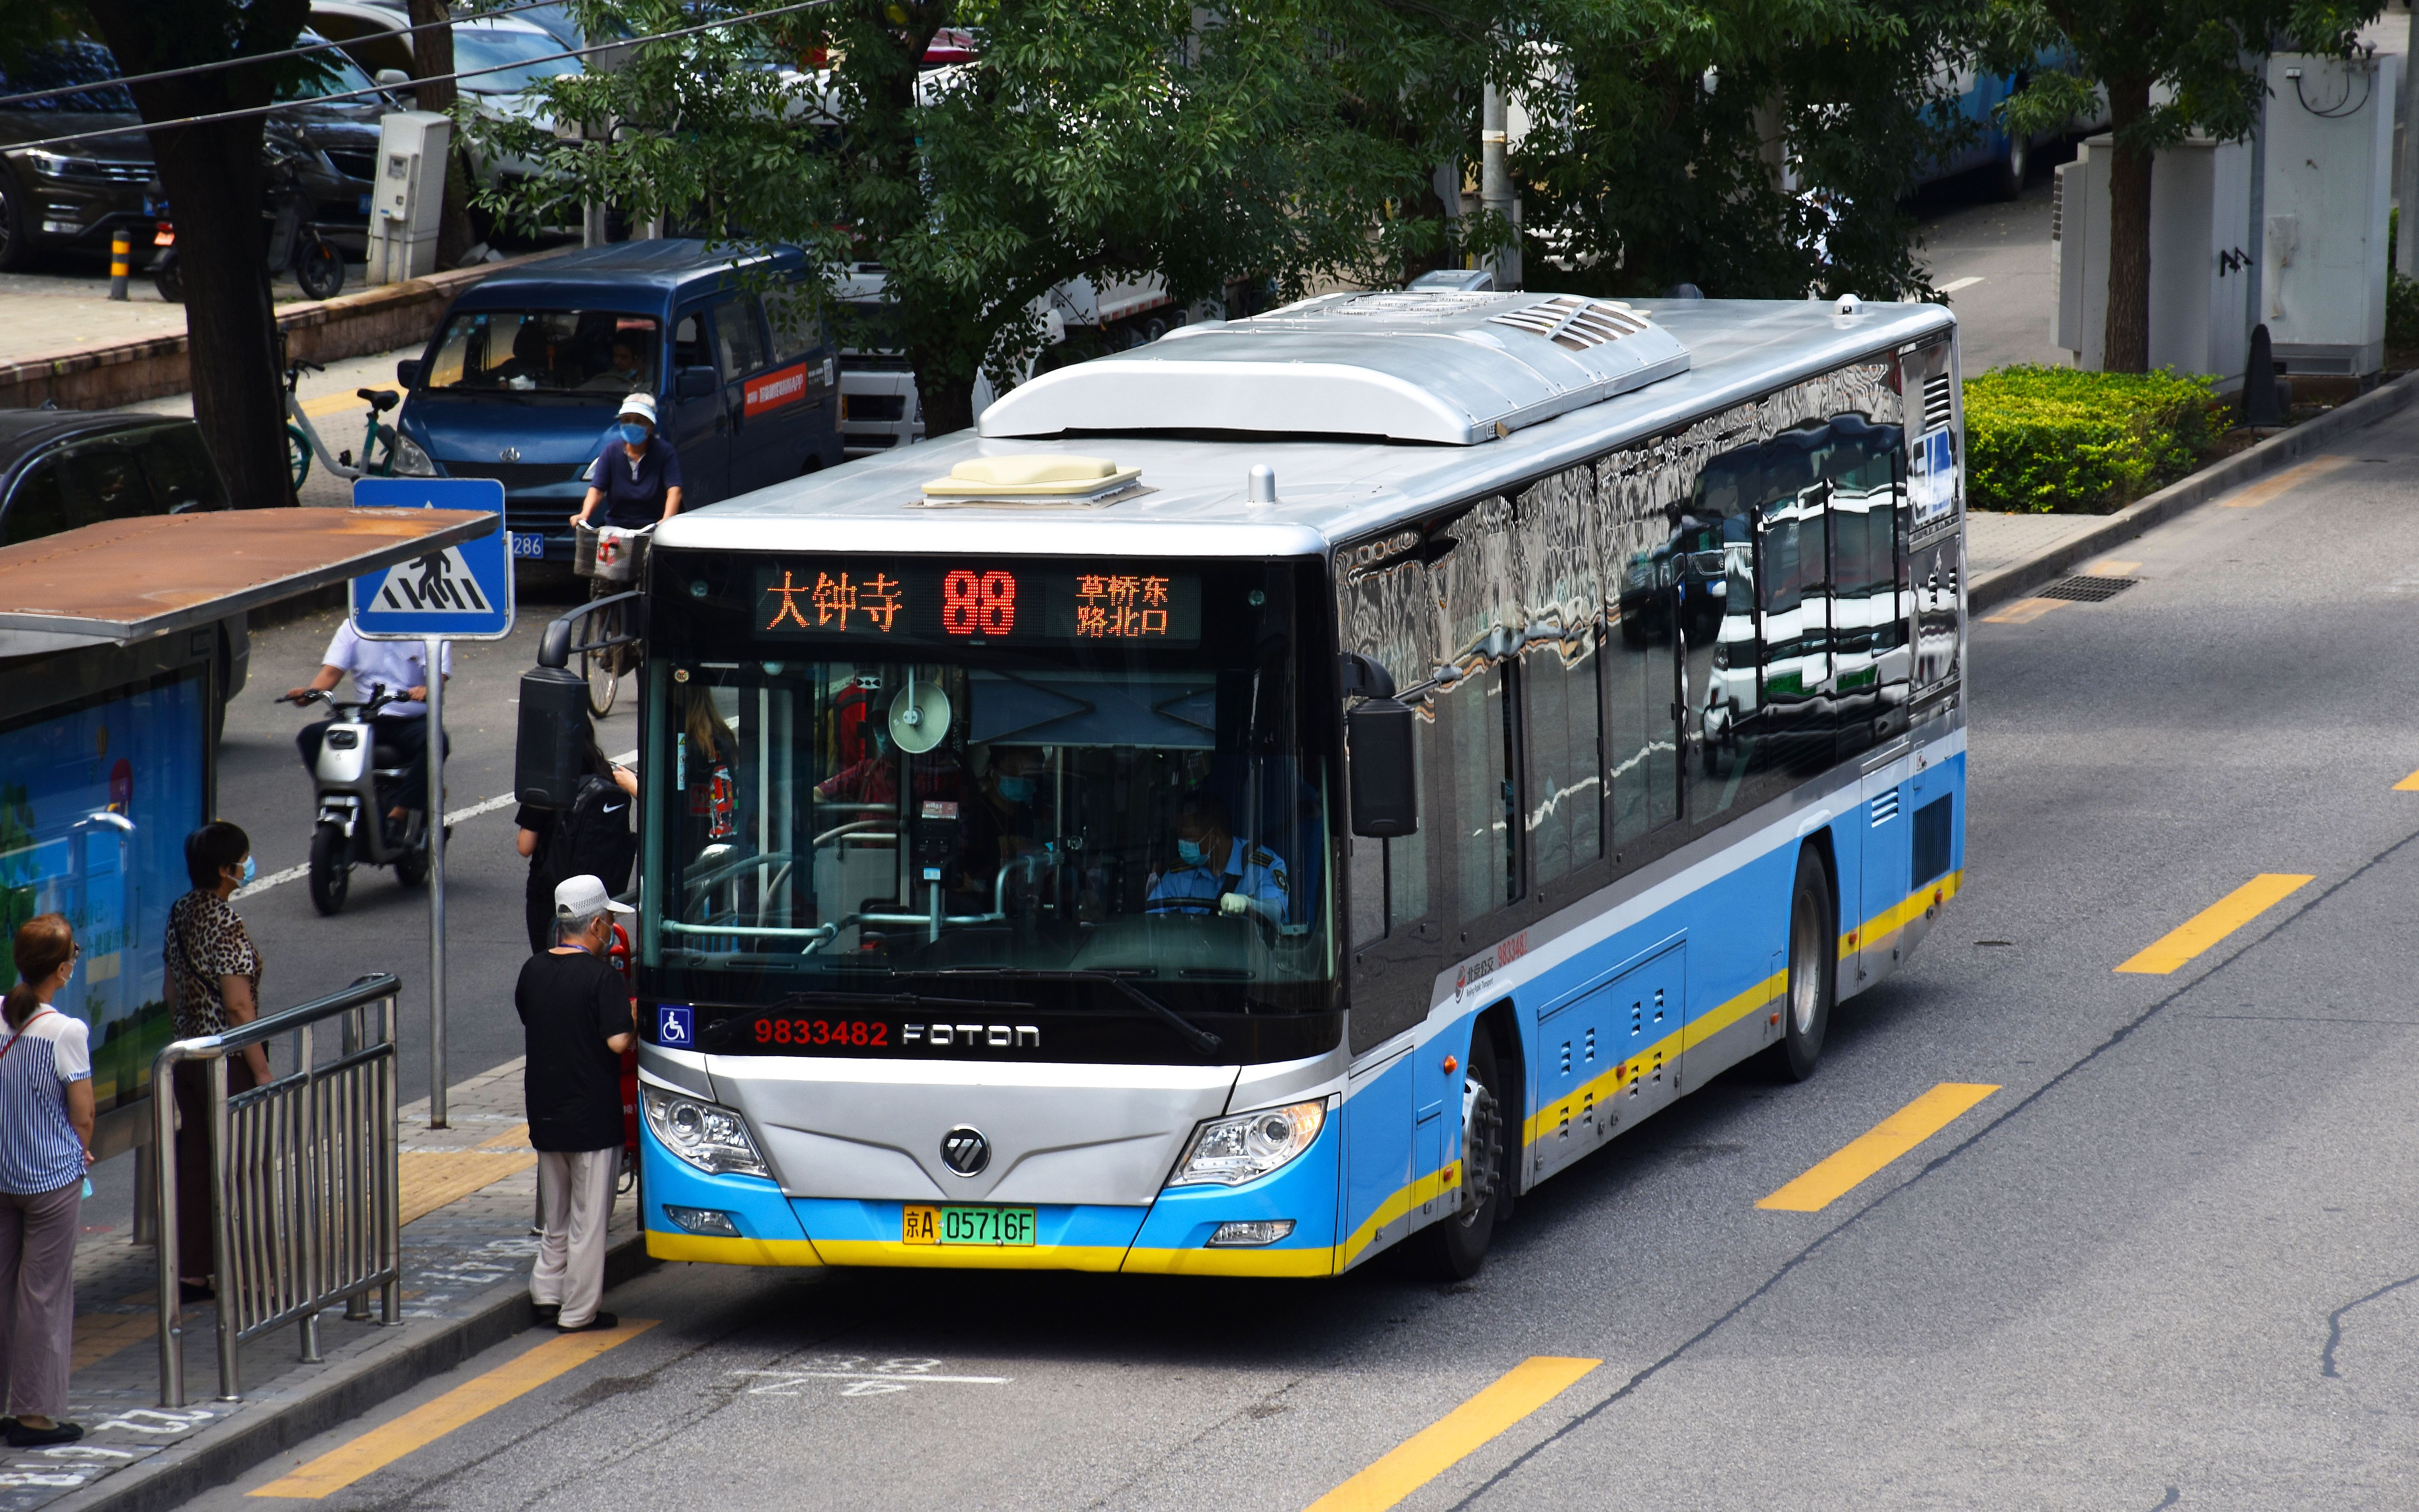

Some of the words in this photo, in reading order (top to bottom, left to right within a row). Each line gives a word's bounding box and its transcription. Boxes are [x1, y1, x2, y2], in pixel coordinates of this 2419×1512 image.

[514, 537, 541, 555] 286
[766, 571, 903, 631] 大钟寺
[942, 570, 1015, 635] 88
[1076, 575, 1169, 607] 草桥东
[1076, 606, 1168, 638] 路北口
[1498, 930, 1528, 967] 9833482
[1467, 957, 1494, 984] 北京公交
[755, 1019, 888, 1046] 9833482
[902, 1024, 1040, 1047] FOTON
[947, 1211, 1031, 1242] 05716F
